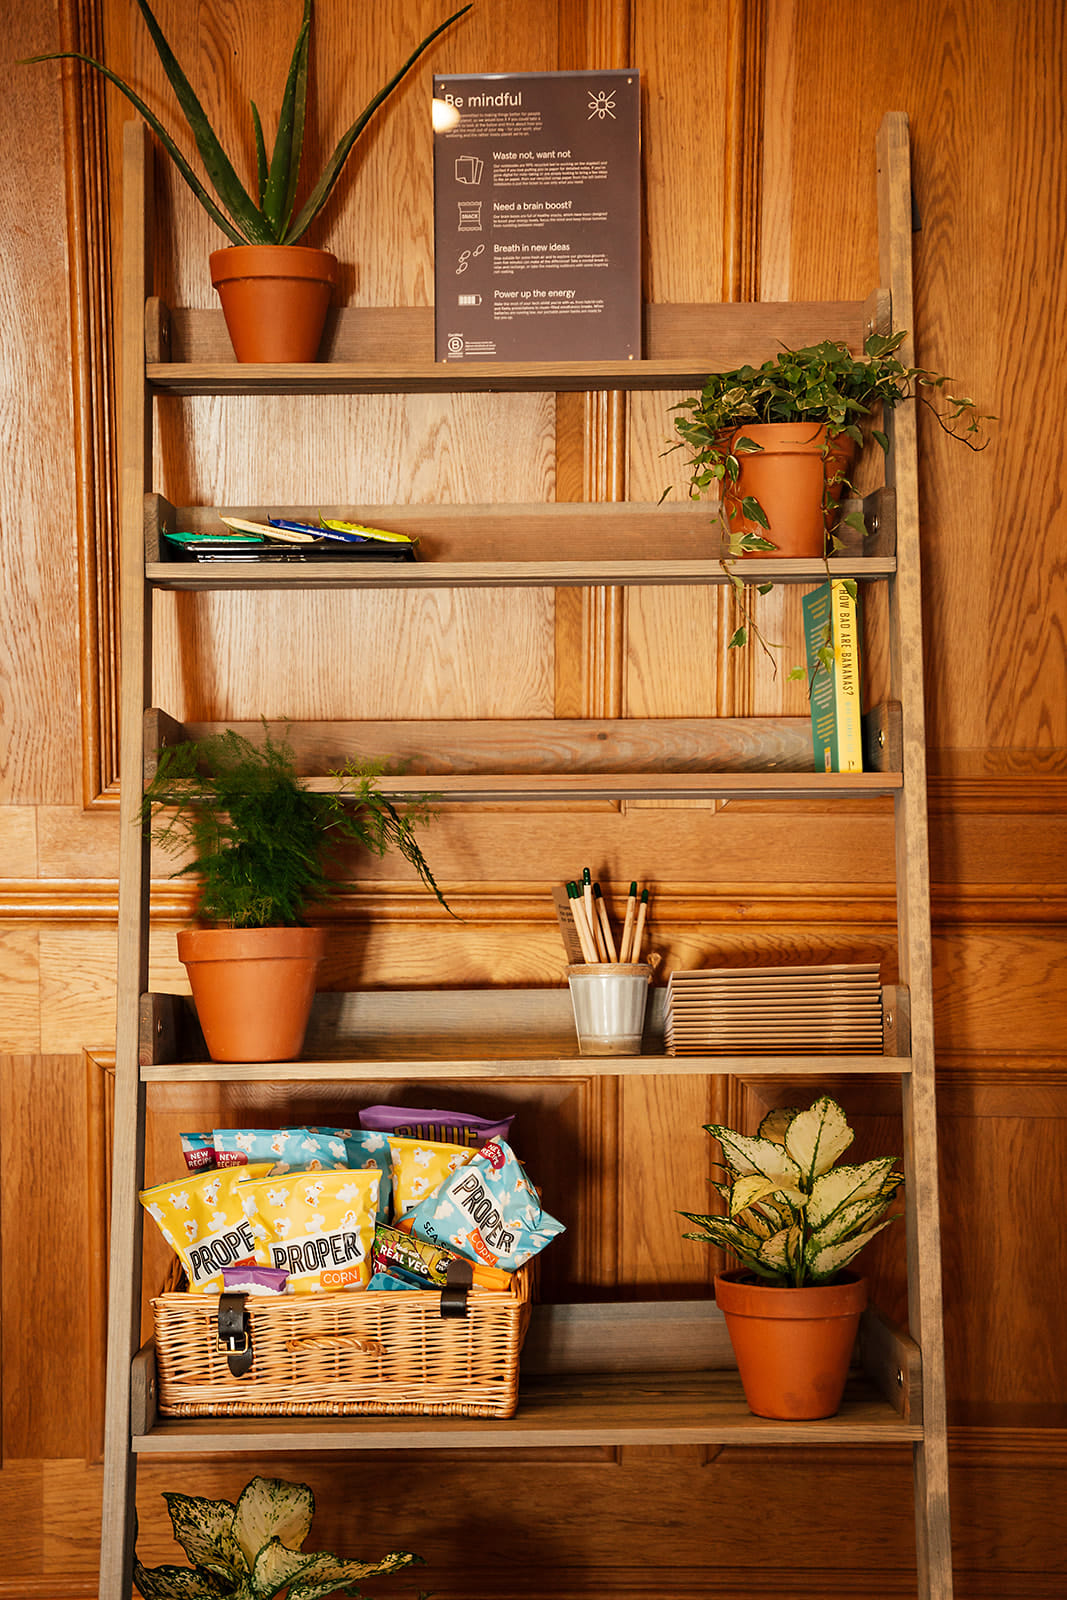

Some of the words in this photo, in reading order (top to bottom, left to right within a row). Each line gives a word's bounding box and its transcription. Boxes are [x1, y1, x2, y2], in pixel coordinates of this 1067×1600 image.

[445, 94, 463, 107] Be
[468, 92, 522, 107] mindful
[493, 151, 517, 160] Waste
[519, 150, 534, 160] not,
[536, 150, 555, 159] want
[557, 150, 571, 158] not
[493, 202, 514, 211] Need
[523, 201, 544, 210] brain
[545, 200, 572, 209] boost?
[493, 244, 520, 253] Breath
[522, 244, 529, 252] in
[549, 243, 570, 252] ideas
[494, 290, 519, 298] Power
[521, 290, 531, 299] up
[533, 289, 546, 297] the
[548, 290, 576, 299] energy
[839, 589, 849, 608] HOW
[840, 612, 851, 629] BAD
[841, 633, 852, 648] ARE
[841, 652, 854, 696] BANANAS?
[190, 1151, 208, 1160] NEW
[219, 1153, 238, 1161] NEW
[488, 1144, 502, 1157] NEW
[188, 1157, 212, 1168] RECIPE
[452, 1173, 515, 1253] PROPER
[424, 1221, 438, 1243] SEA
[272, 1231, 362, 1275] PROPER
[471, 1232, 496, 1266] CORN
[380, 1244, 405, 1264] REAL
[408, 1257, 429, 1274] VEG
[323, 1270, 359, 1284] CORN
